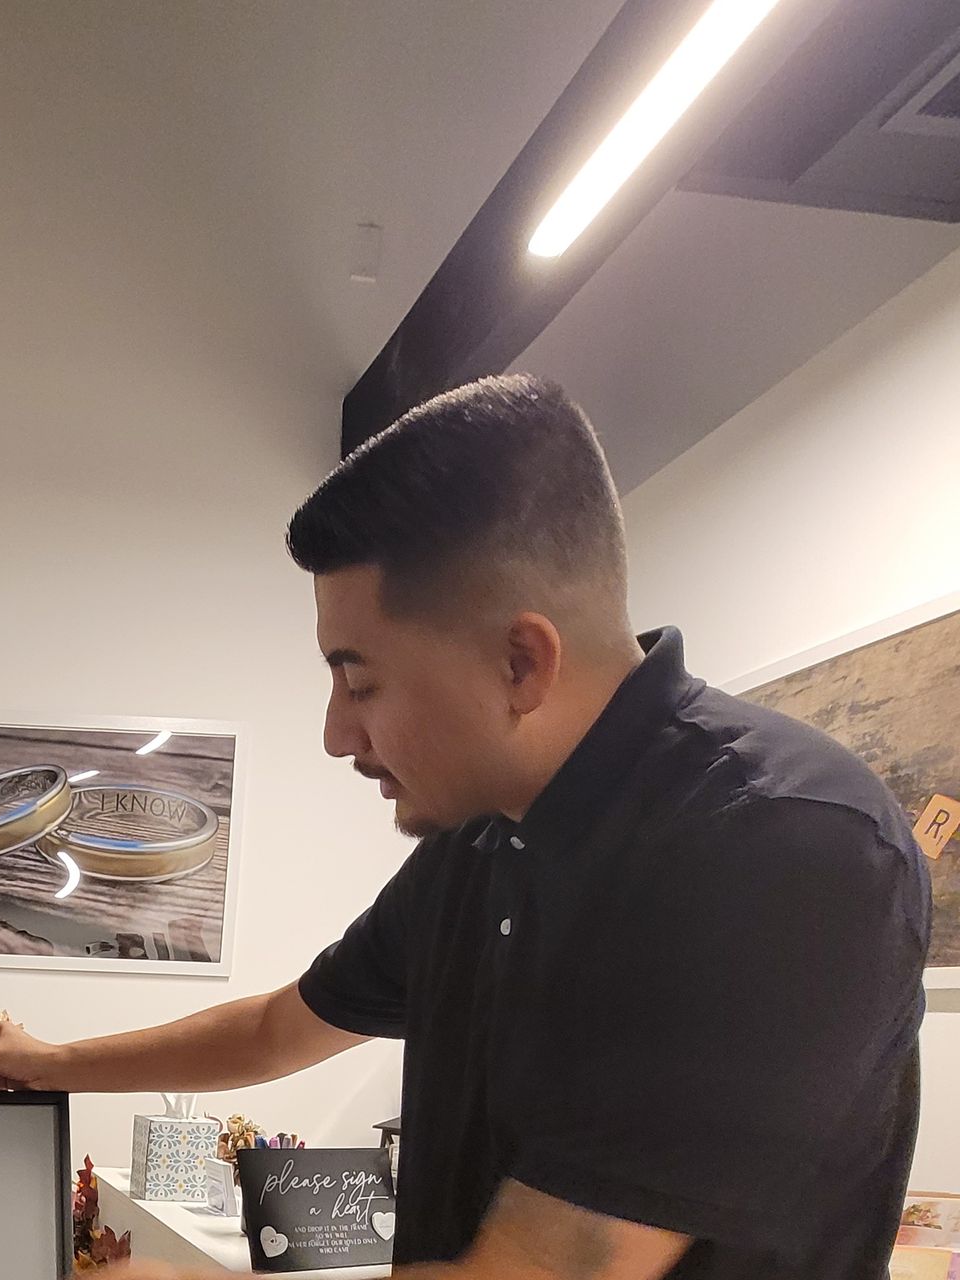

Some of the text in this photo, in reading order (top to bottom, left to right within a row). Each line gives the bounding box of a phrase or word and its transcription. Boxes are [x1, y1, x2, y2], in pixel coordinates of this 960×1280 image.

[116, 793, 187, 823] KNOW
[259, 1159, 383, 1206] please sign
[309, 1190, 389, 1225] a heart
[308, 1225, 322, 1233] DROP
